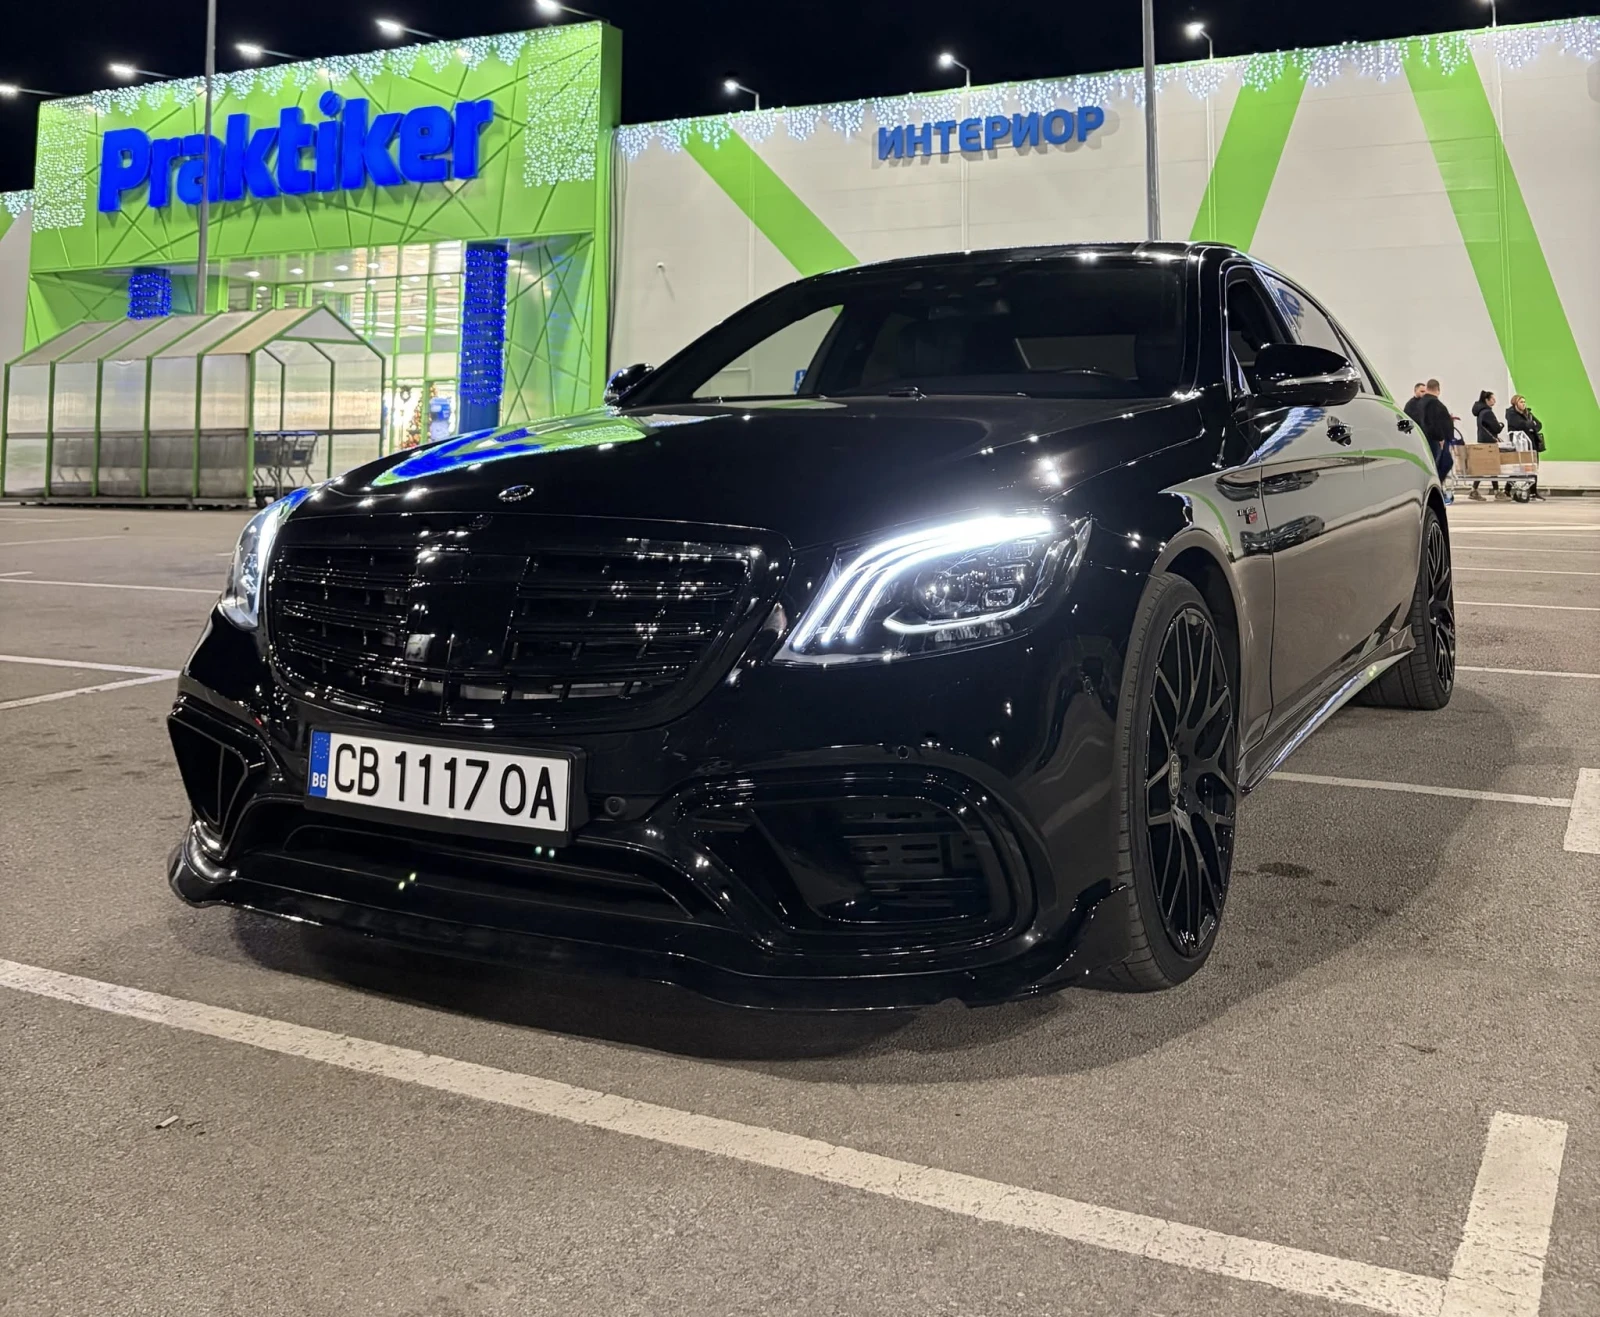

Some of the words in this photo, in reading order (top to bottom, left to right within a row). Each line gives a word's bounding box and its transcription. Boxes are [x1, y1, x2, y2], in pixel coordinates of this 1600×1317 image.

[98, 90, 495, 213] Praktiker
[878, 105, 1105, 161] ИНТЕРИОР
[312, 772, 327, 789] BG
